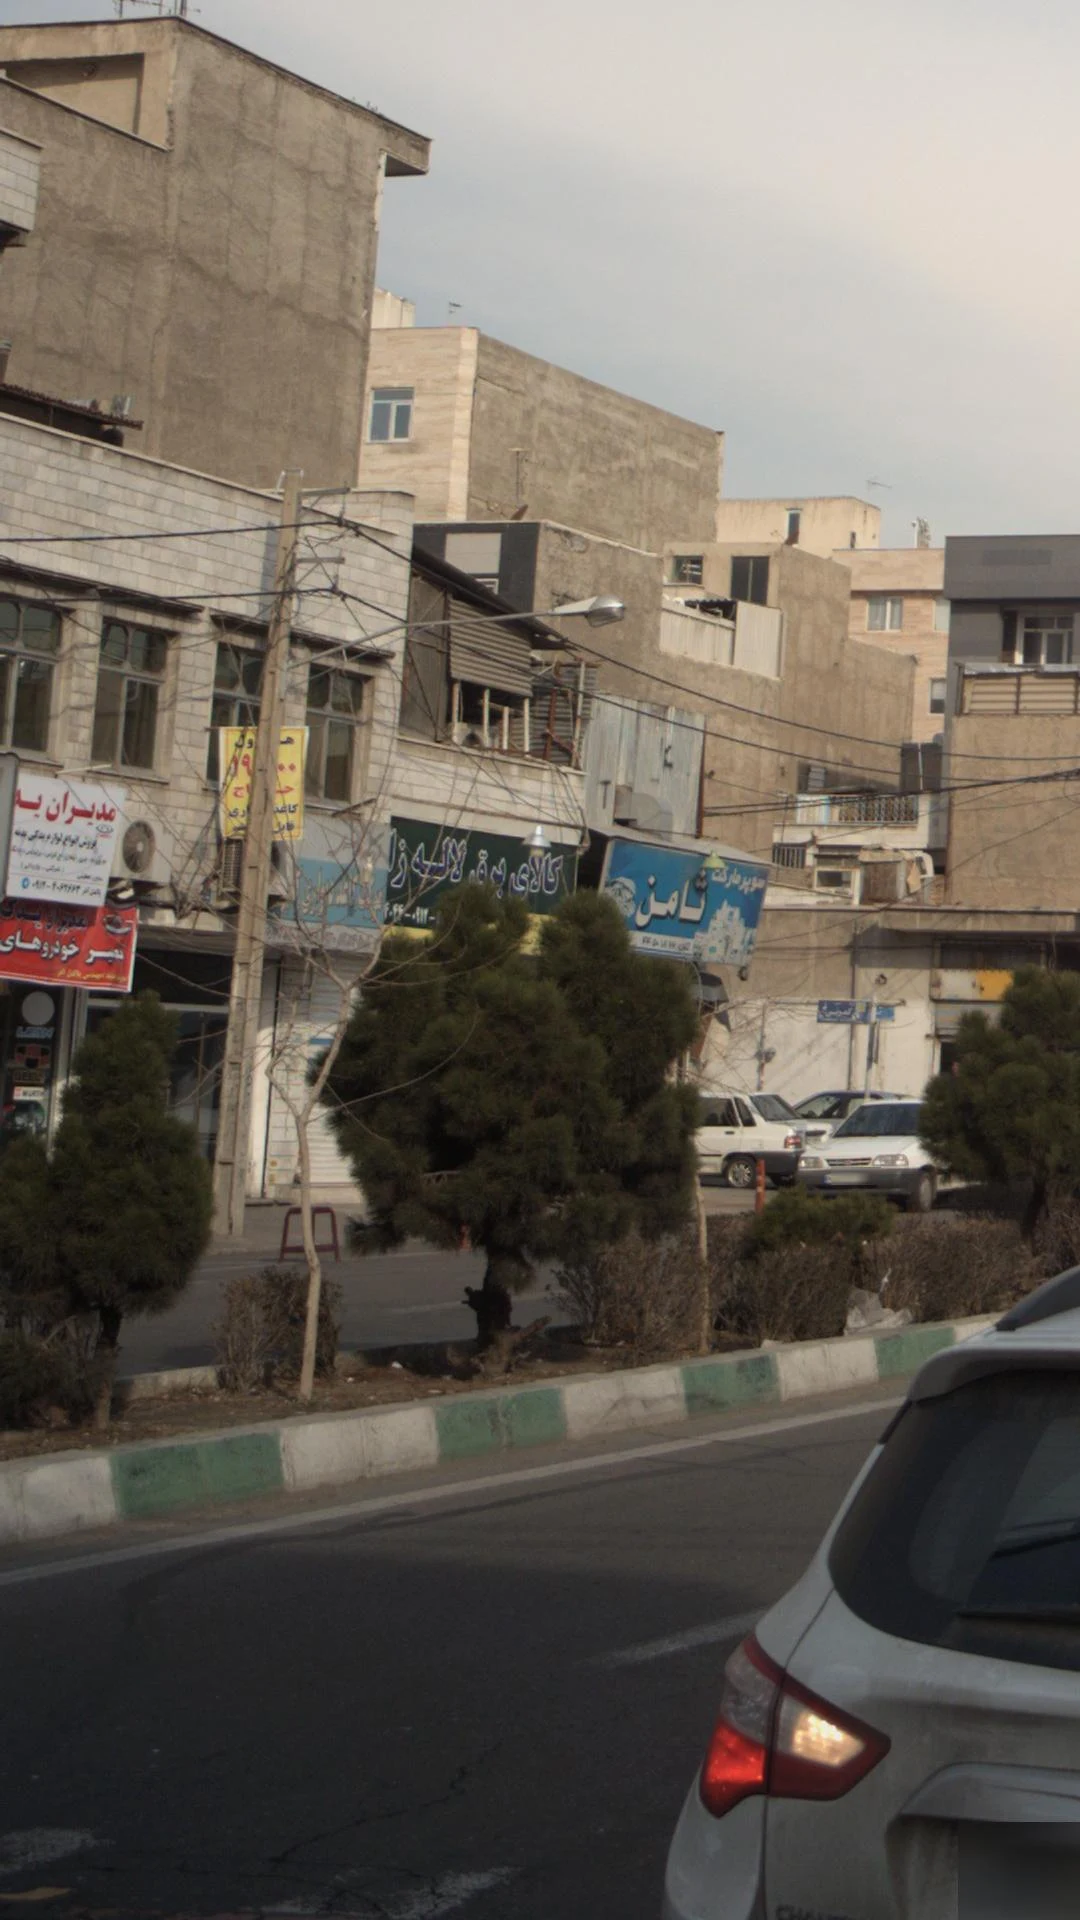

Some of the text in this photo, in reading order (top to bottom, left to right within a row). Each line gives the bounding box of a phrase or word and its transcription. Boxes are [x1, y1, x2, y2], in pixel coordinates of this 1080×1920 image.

[45, 789, 117, 825] مدیران
[411, 836, 468, 882] لاله
[509, 852, 564, 899] کالای
[634, 868, 709, 929] ثامن
